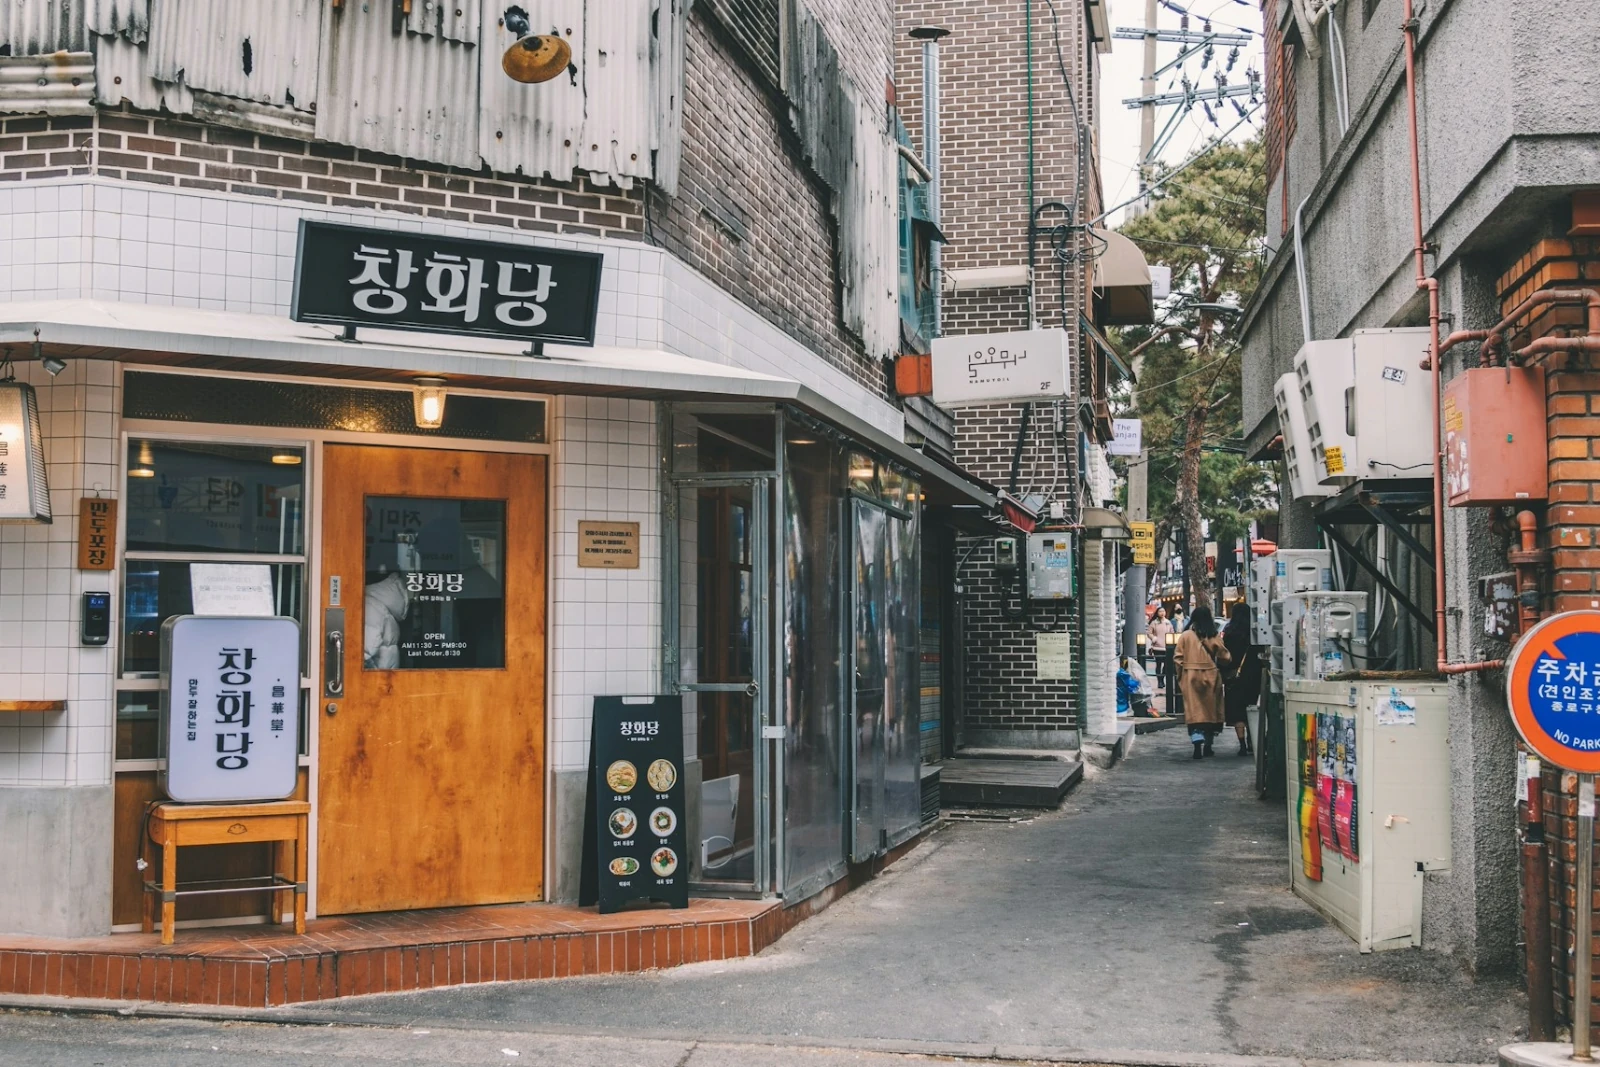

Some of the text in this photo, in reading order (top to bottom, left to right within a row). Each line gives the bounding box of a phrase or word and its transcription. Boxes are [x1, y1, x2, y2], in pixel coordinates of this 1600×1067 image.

[348, 244, 558, 327] 창화당
[1040, 381, 1051, 390] 2F
[88, 502, 108, 566] 만두포장
[406, 572, 464, 593] 창화당
[215, 647, 257, 770] 창화당
[270, 685, 285, 731] 昌華堂
[1538, 684, 1600, 700] (견인조
[187, 678, 198, 741] 만두 잘하는 집
[620, 720, 659, 736] 창화당
[1553, 728, 1569, 745] NO
